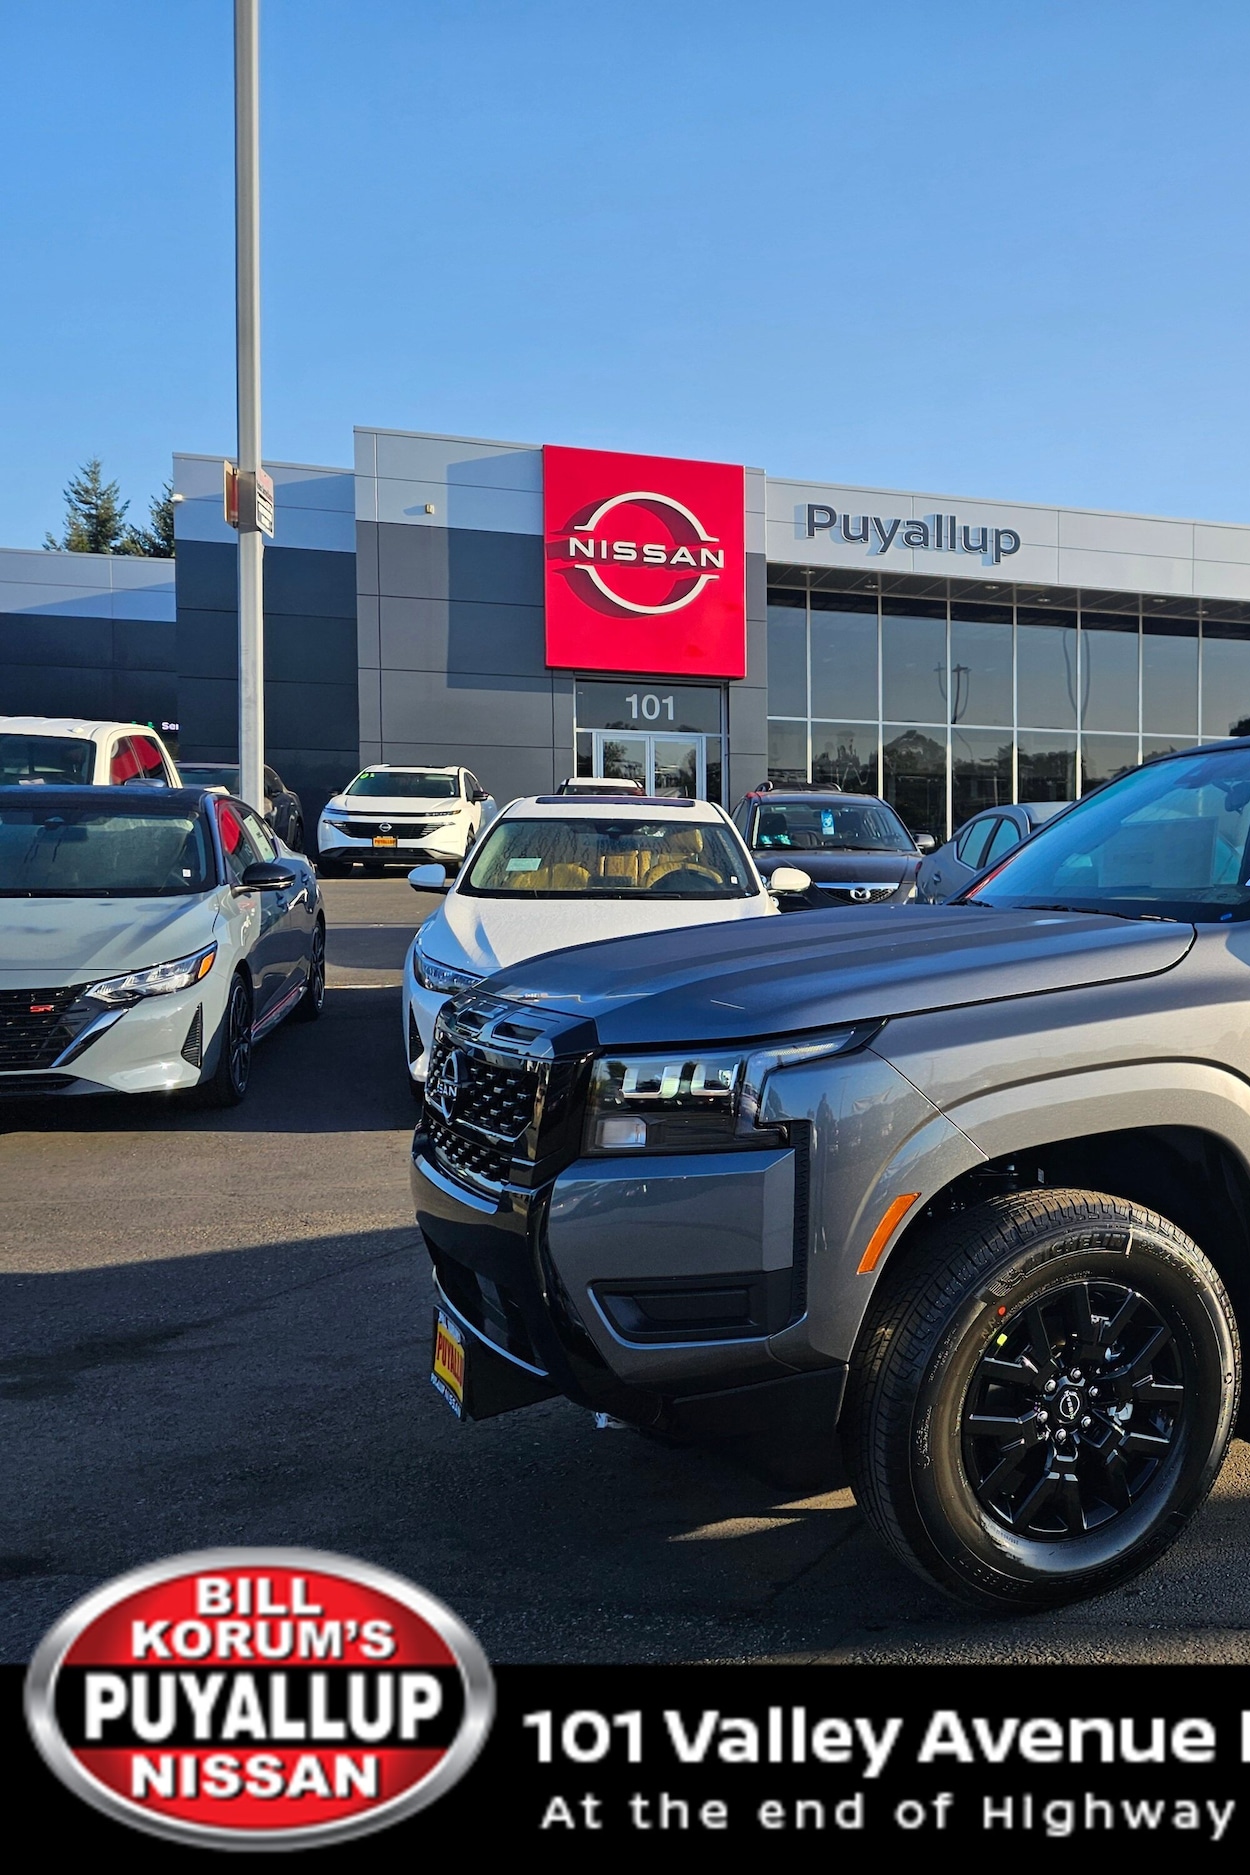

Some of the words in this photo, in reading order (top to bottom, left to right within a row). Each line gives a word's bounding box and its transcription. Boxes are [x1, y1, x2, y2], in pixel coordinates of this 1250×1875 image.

[806, 502, 1021, 564] Puyallup
[569, 536, 724, 569] NISSAN
[625, 694, 674, 721] 101
